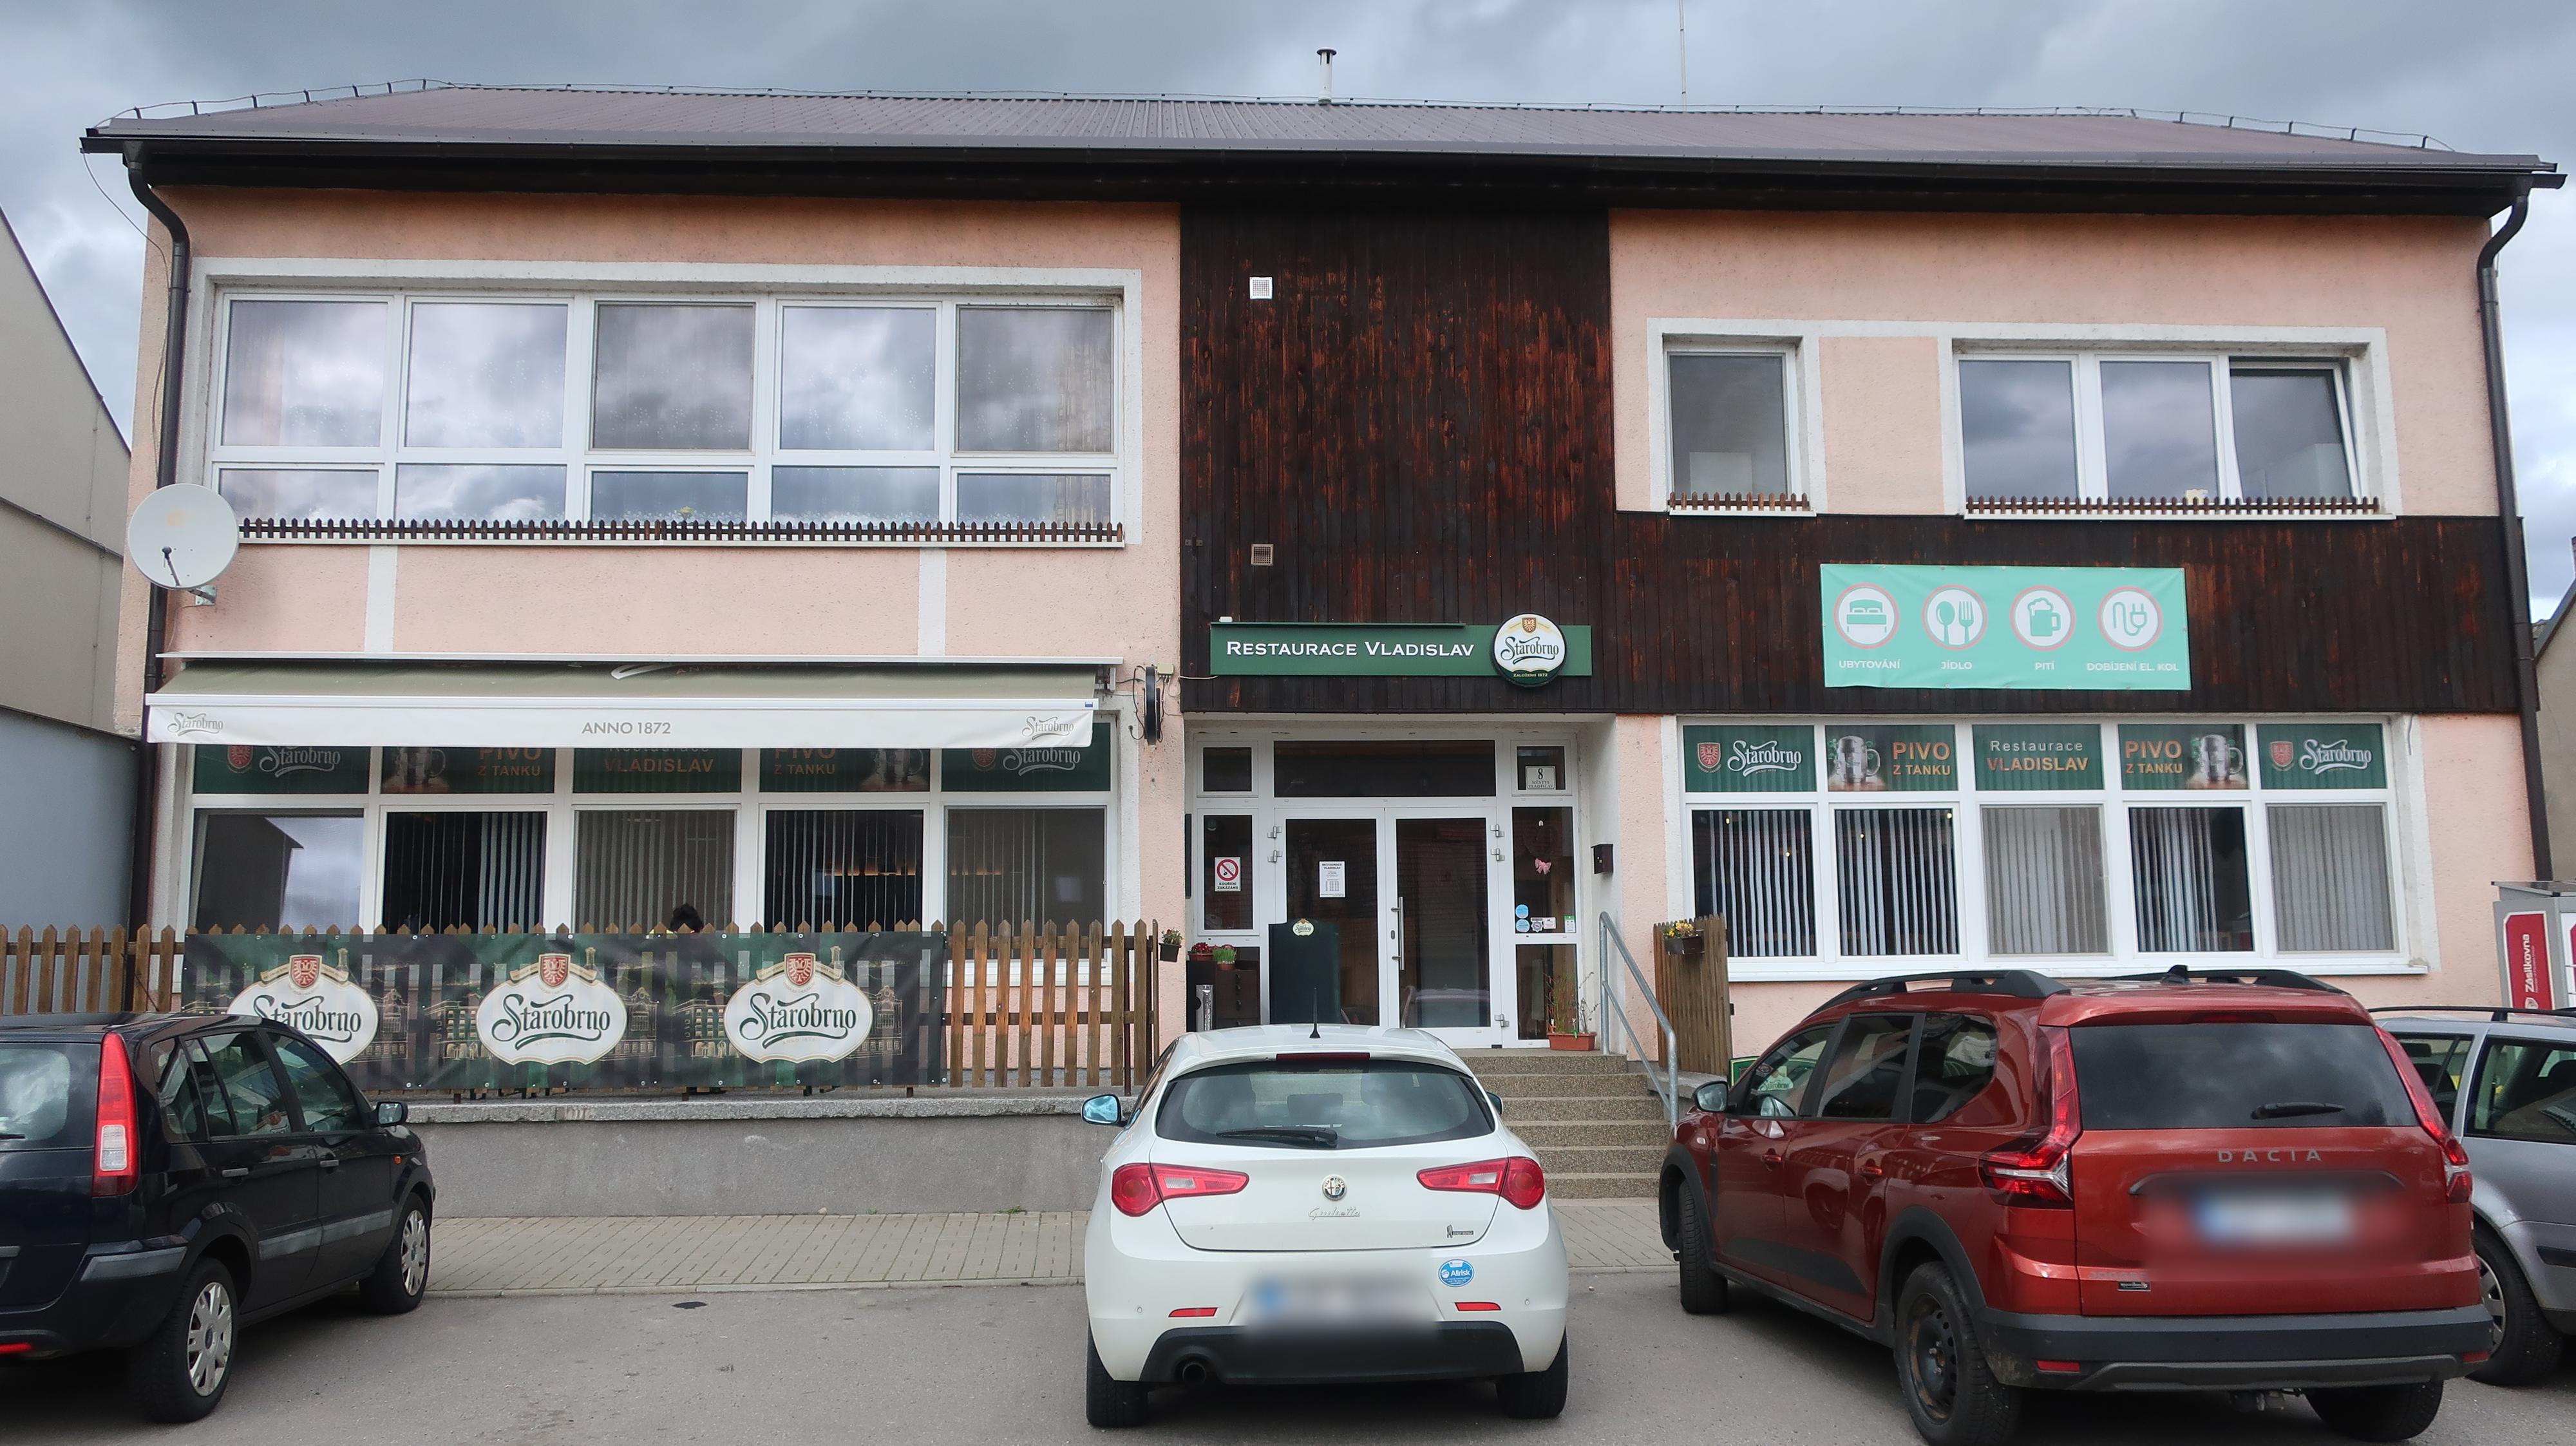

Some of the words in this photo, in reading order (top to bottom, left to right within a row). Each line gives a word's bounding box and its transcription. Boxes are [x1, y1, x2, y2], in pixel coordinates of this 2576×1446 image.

[1227, 641, 1358, 656] RESTAURACE
[1365, 642, 1474, 656] VLADISLAV
[1501, 636, 1559, 665] Starobrno
[1839, 659, 1900, 669] UBYTOVÁNÍ
[1940, 660, 1973, 670] JÍDLO
[2035, 660, 2055, 670] PITÍ
[2087, 661, 2137, 671] DOBÍJENÍ
[2157, 663, 2179, 671] KOL
[167, 712, 223, 736] Starobrno
[582, 722, 633, 734] ANNO
[638, 722, 671, 734] 1872
[1021, 716, 1074, 741] Starobrno
[1893, 741, 1951, 760] PIVO
[1990, 740, 2083, 752] Restaurace
[2125, 740, 2183, 759] PIVO
[259, 746, 341, 778] Starobrno
[1003, 748, 1081, 776] Starobrno
[1727, 740, 1802, 777] Starobrno
[2298, 739, 2372, 774] Starobrno
[492, 765, 541, 776] TANKU
[604, 758, 714, 773] VLADISLAV
[788, 764, 836, 775] TANKU
[1893, 765, 1902, 775] Z
[1906, 765, 1951, 775] TANKU
[1987, 757, 2088, 772] VLADISLAV
[2126, 763, 2135, 774] Z
[2138, 763, 2183, 774] TANKU
[1538, 768, 1543, 779] 8
[491, 993, 611, 1051] Starobrno
[739, 993, 857, 1049] Starobrno
[2218, 1148, 2322, 1162] DACIA
